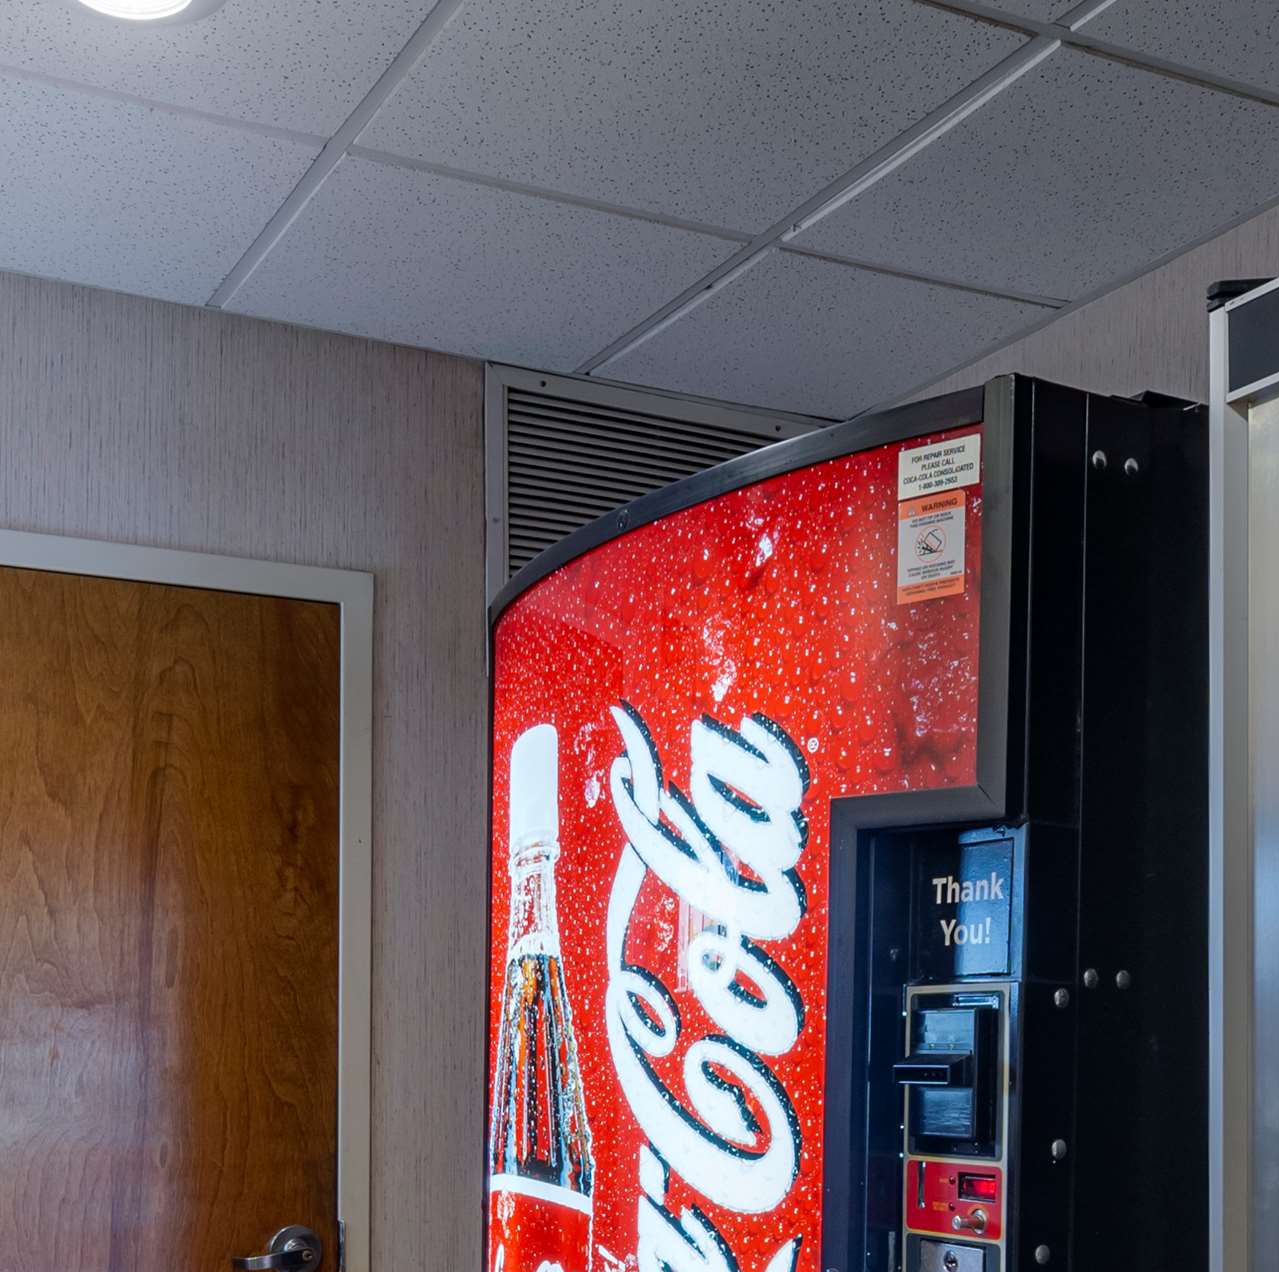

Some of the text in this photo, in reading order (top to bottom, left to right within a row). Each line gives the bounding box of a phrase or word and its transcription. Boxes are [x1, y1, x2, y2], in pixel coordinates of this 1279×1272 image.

[911, 445, 966, 464] FOR REPAIR SERVICE
[921, 458, 955, 472] PLEASE CALL
[921, 498, 958, 513] WARNING
[932, 871, 1004, 906] Thank
[940, 916, 992, 947] You!
